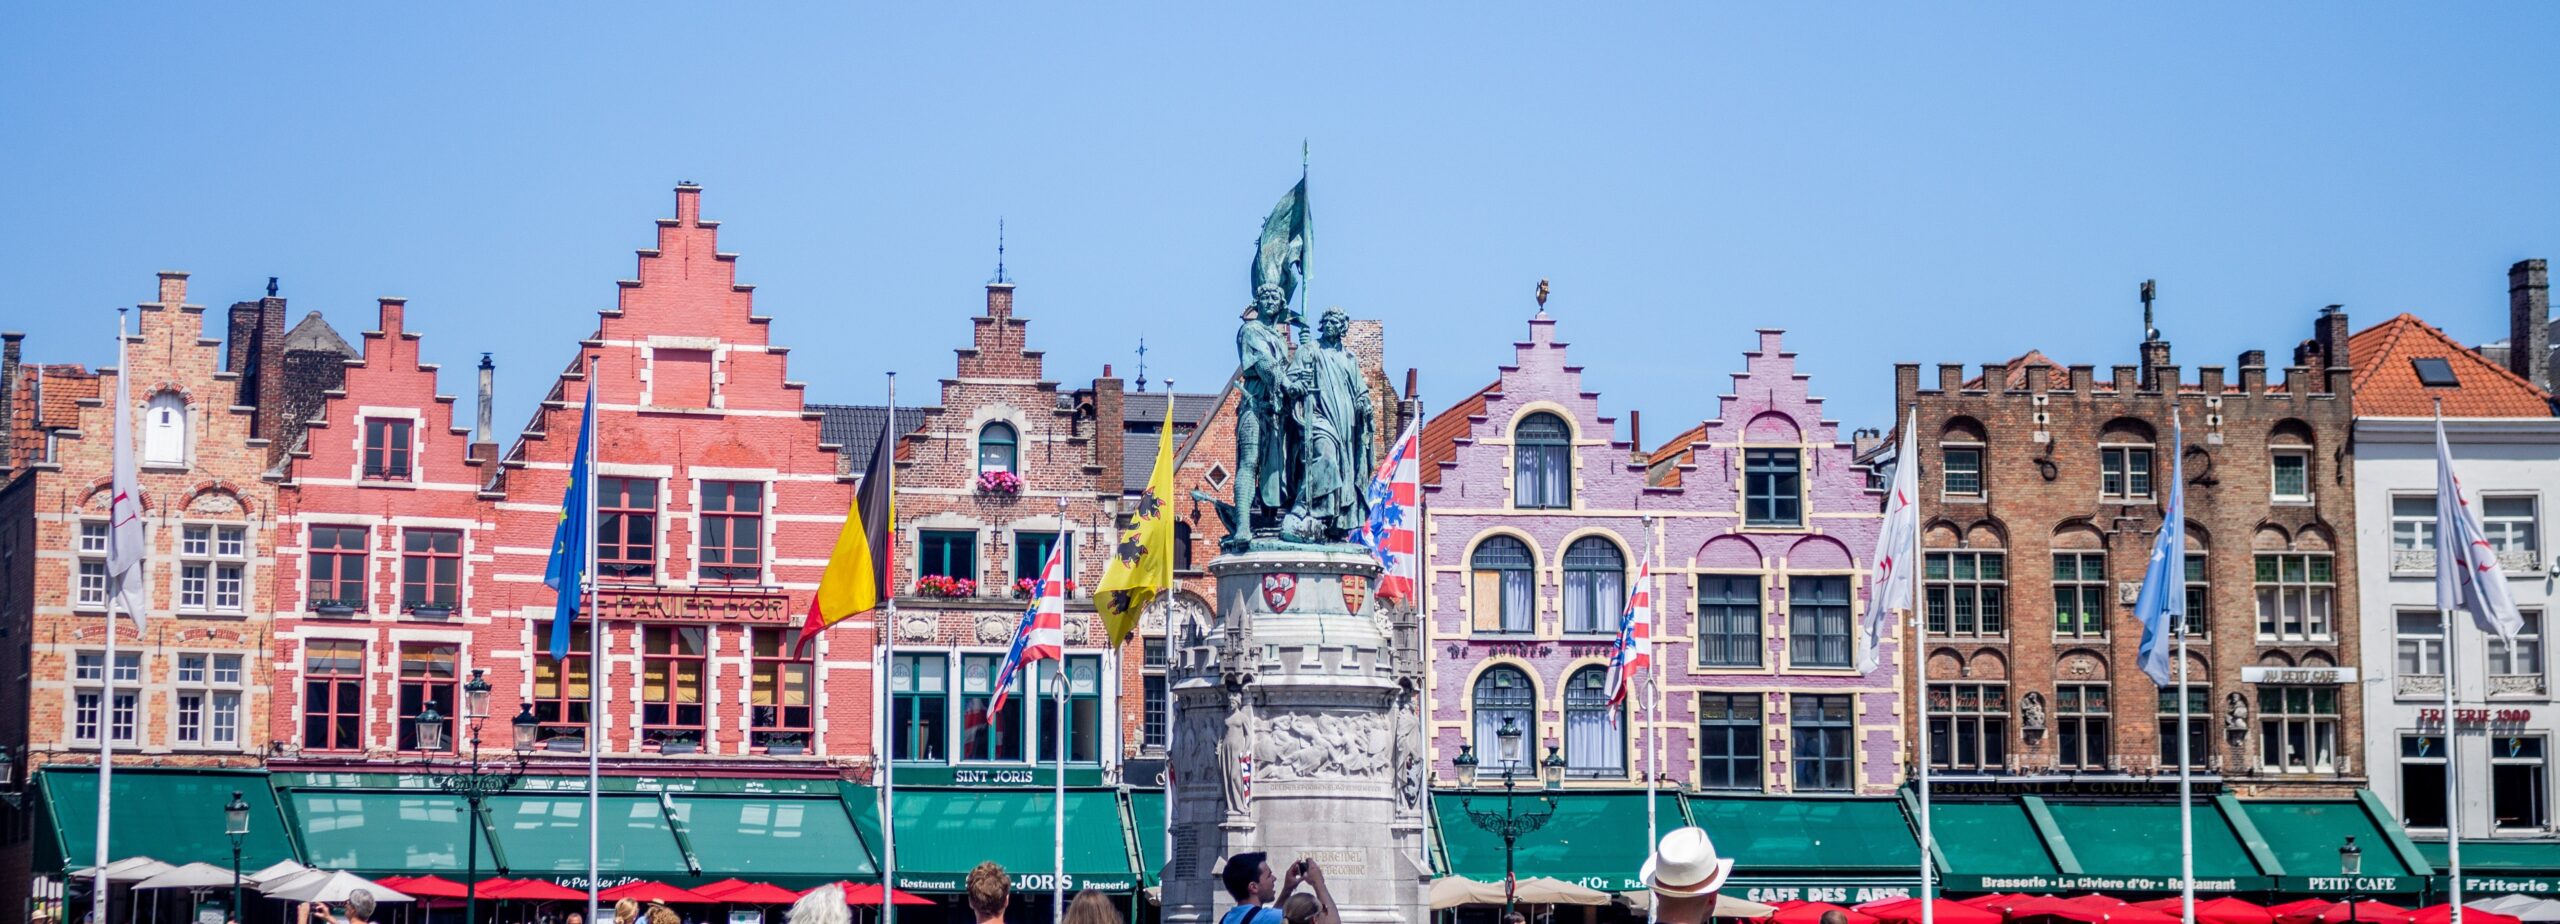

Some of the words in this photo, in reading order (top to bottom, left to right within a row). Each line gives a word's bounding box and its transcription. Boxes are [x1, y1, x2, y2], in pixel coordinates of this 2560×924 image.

[615, 594, 713, 619] PANIER
[724, 598, 783, 620] D'OR
[2281, 670, 2310, 681] PETIT
[2420, 708, 2491, 722] FRIERIE
[2496, 709, 2531, 722] 1900
[956, 770, 988, 783] SINT
[993, 770, 1033, 783] JORIS
[1933, 783, 2042, 793] ESTAURANT
[572, 876, 616, 888] Paier
[901, 878, 956, 890] Restaurant
[1083, 880, 1130, 890] Brasserie
[1578, 877, 1608, 889] d'Or
[1982, 876, 2047, 888] Brasserie
[2058, 877, 2075, 888] La
[2077, 877, 2124, 889] Civiere
[2127, 878, 2155, 889] d'Or
[2168, 878, 2236, 890] Retaurant
[2309, 877, 2352, 890] PETIT
[2355, 877, 2396, 890] CAFE
[2466, 879, 2549, 891] Friterie
[1747, 888, 1800, 902] CAFE
[1808, 888, 1847, 902] DES
